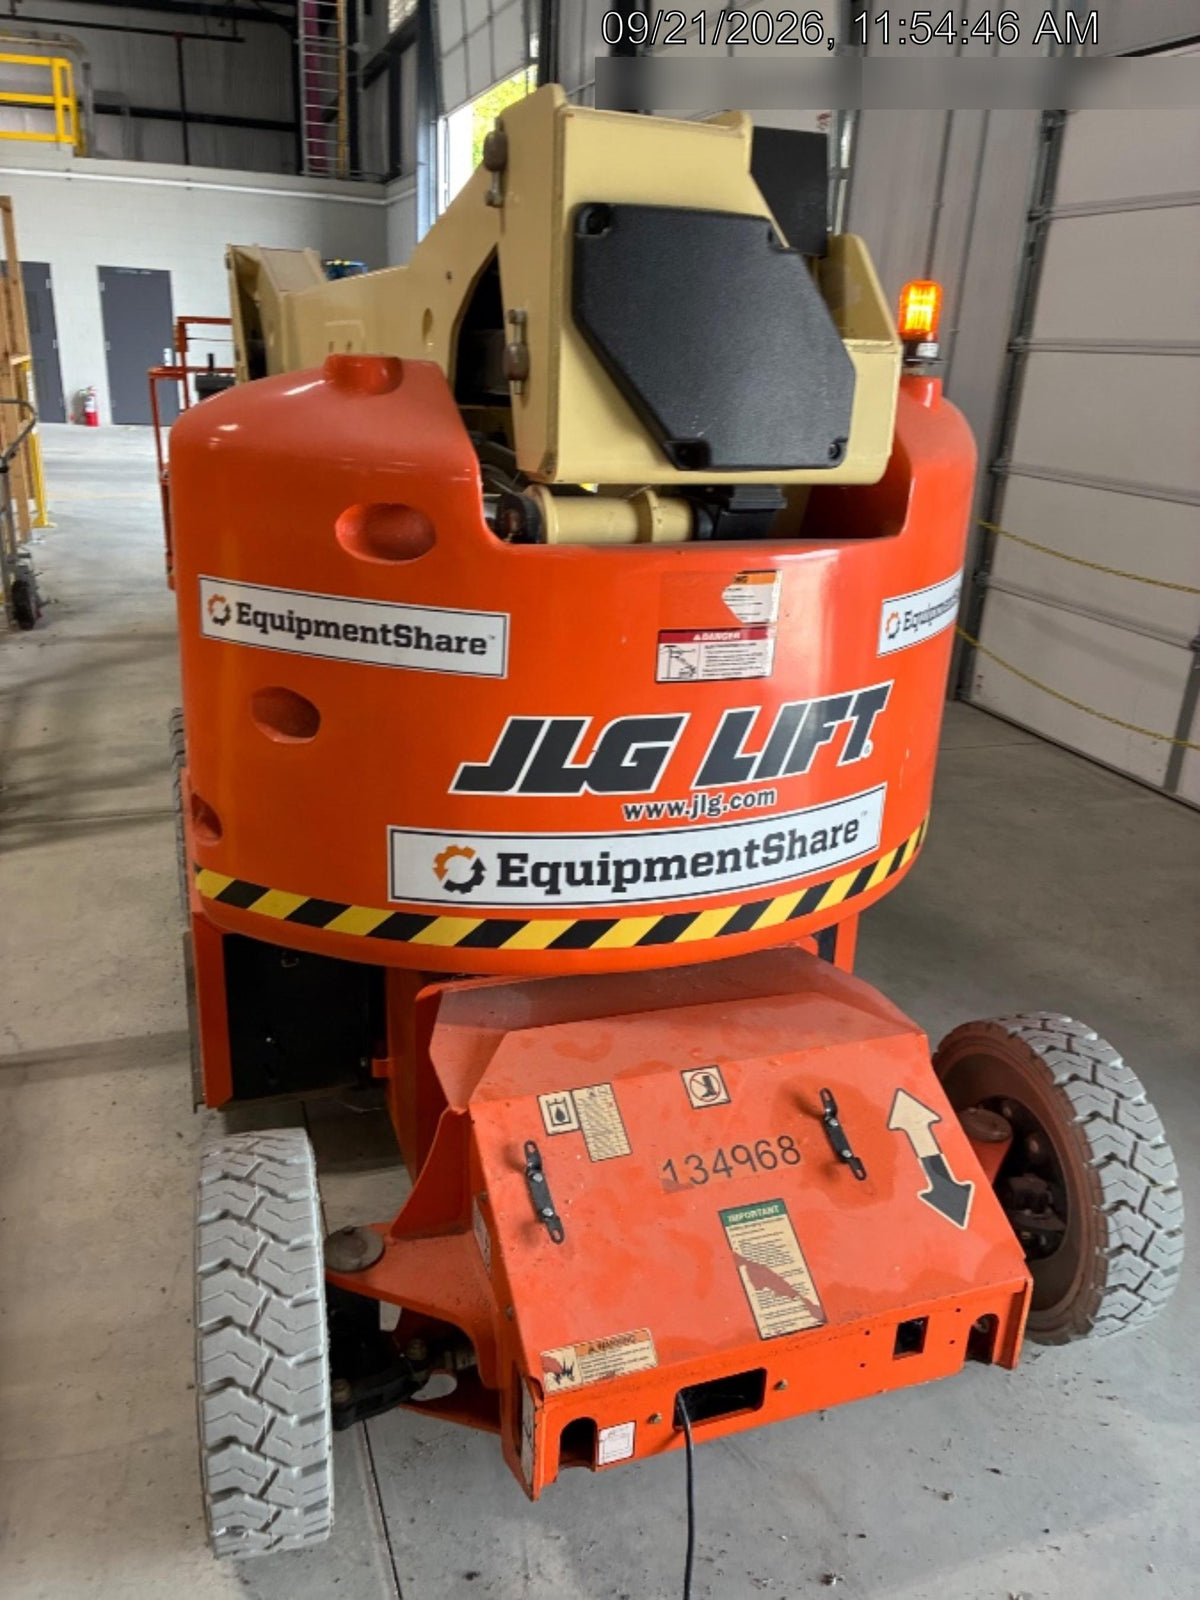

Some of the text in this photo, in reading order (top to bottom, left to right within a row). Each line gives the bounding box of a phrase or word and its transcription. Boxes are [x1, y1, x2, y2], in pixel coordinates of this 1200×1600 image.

[235, 601, 488, 656] EquipmentShare
[701, 631, 742, 641] DANGER
[449, 681, 893, 796] JLG LIFT
[622, 788, 776, 821] www.jlg.com
[496, 817, 860, 895] EquipmentShare
[662, 1135, 801, 1185] 134968
[726, 1204, 780, 1223] IMPORTANT
[597, 1333, 637, 1351] WARNING
